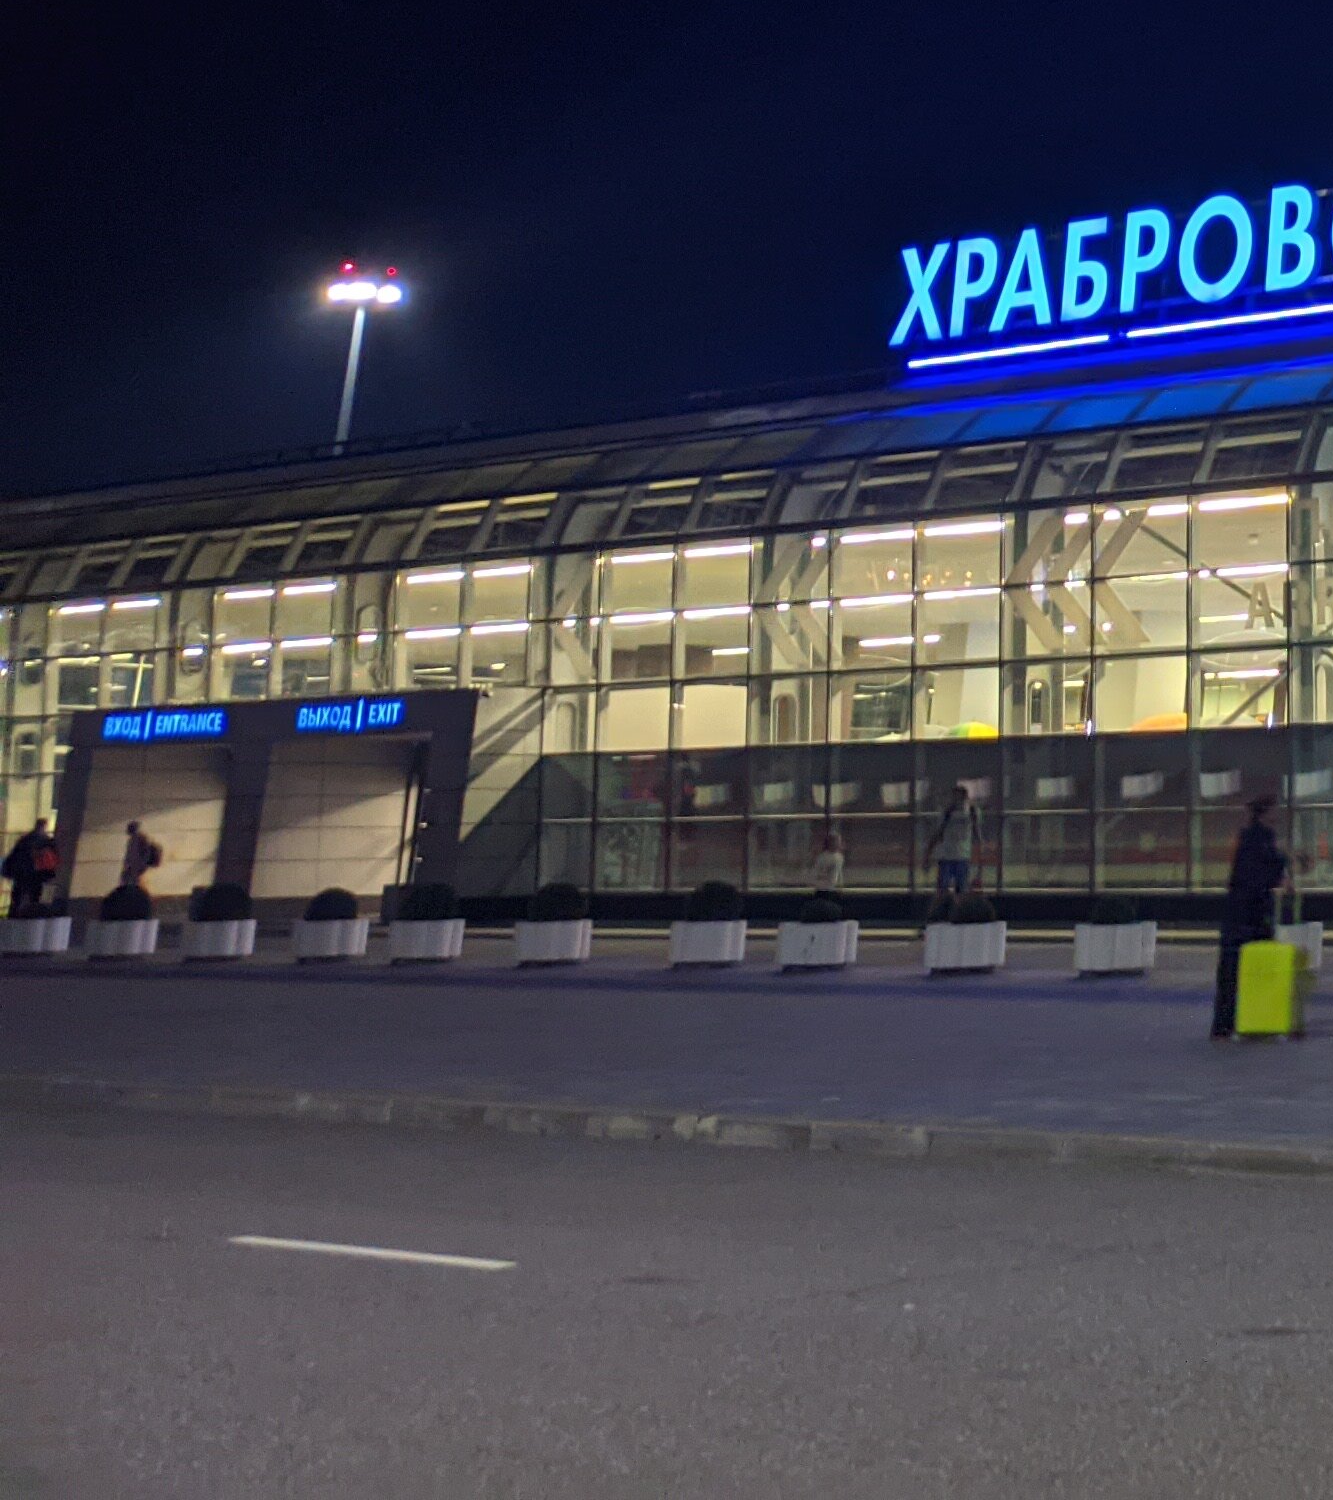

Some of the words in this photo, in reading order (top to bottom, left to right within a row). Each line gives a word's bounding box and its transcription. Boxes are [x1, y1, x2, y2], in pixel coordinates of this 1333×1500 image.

[154, 711, 224, 735] ENTRANCE
[298, 705, 352, 731] ВЫХОД
[368, 702, 401, 724] EXIT
[103, 715, 142, 739] ВХОД
